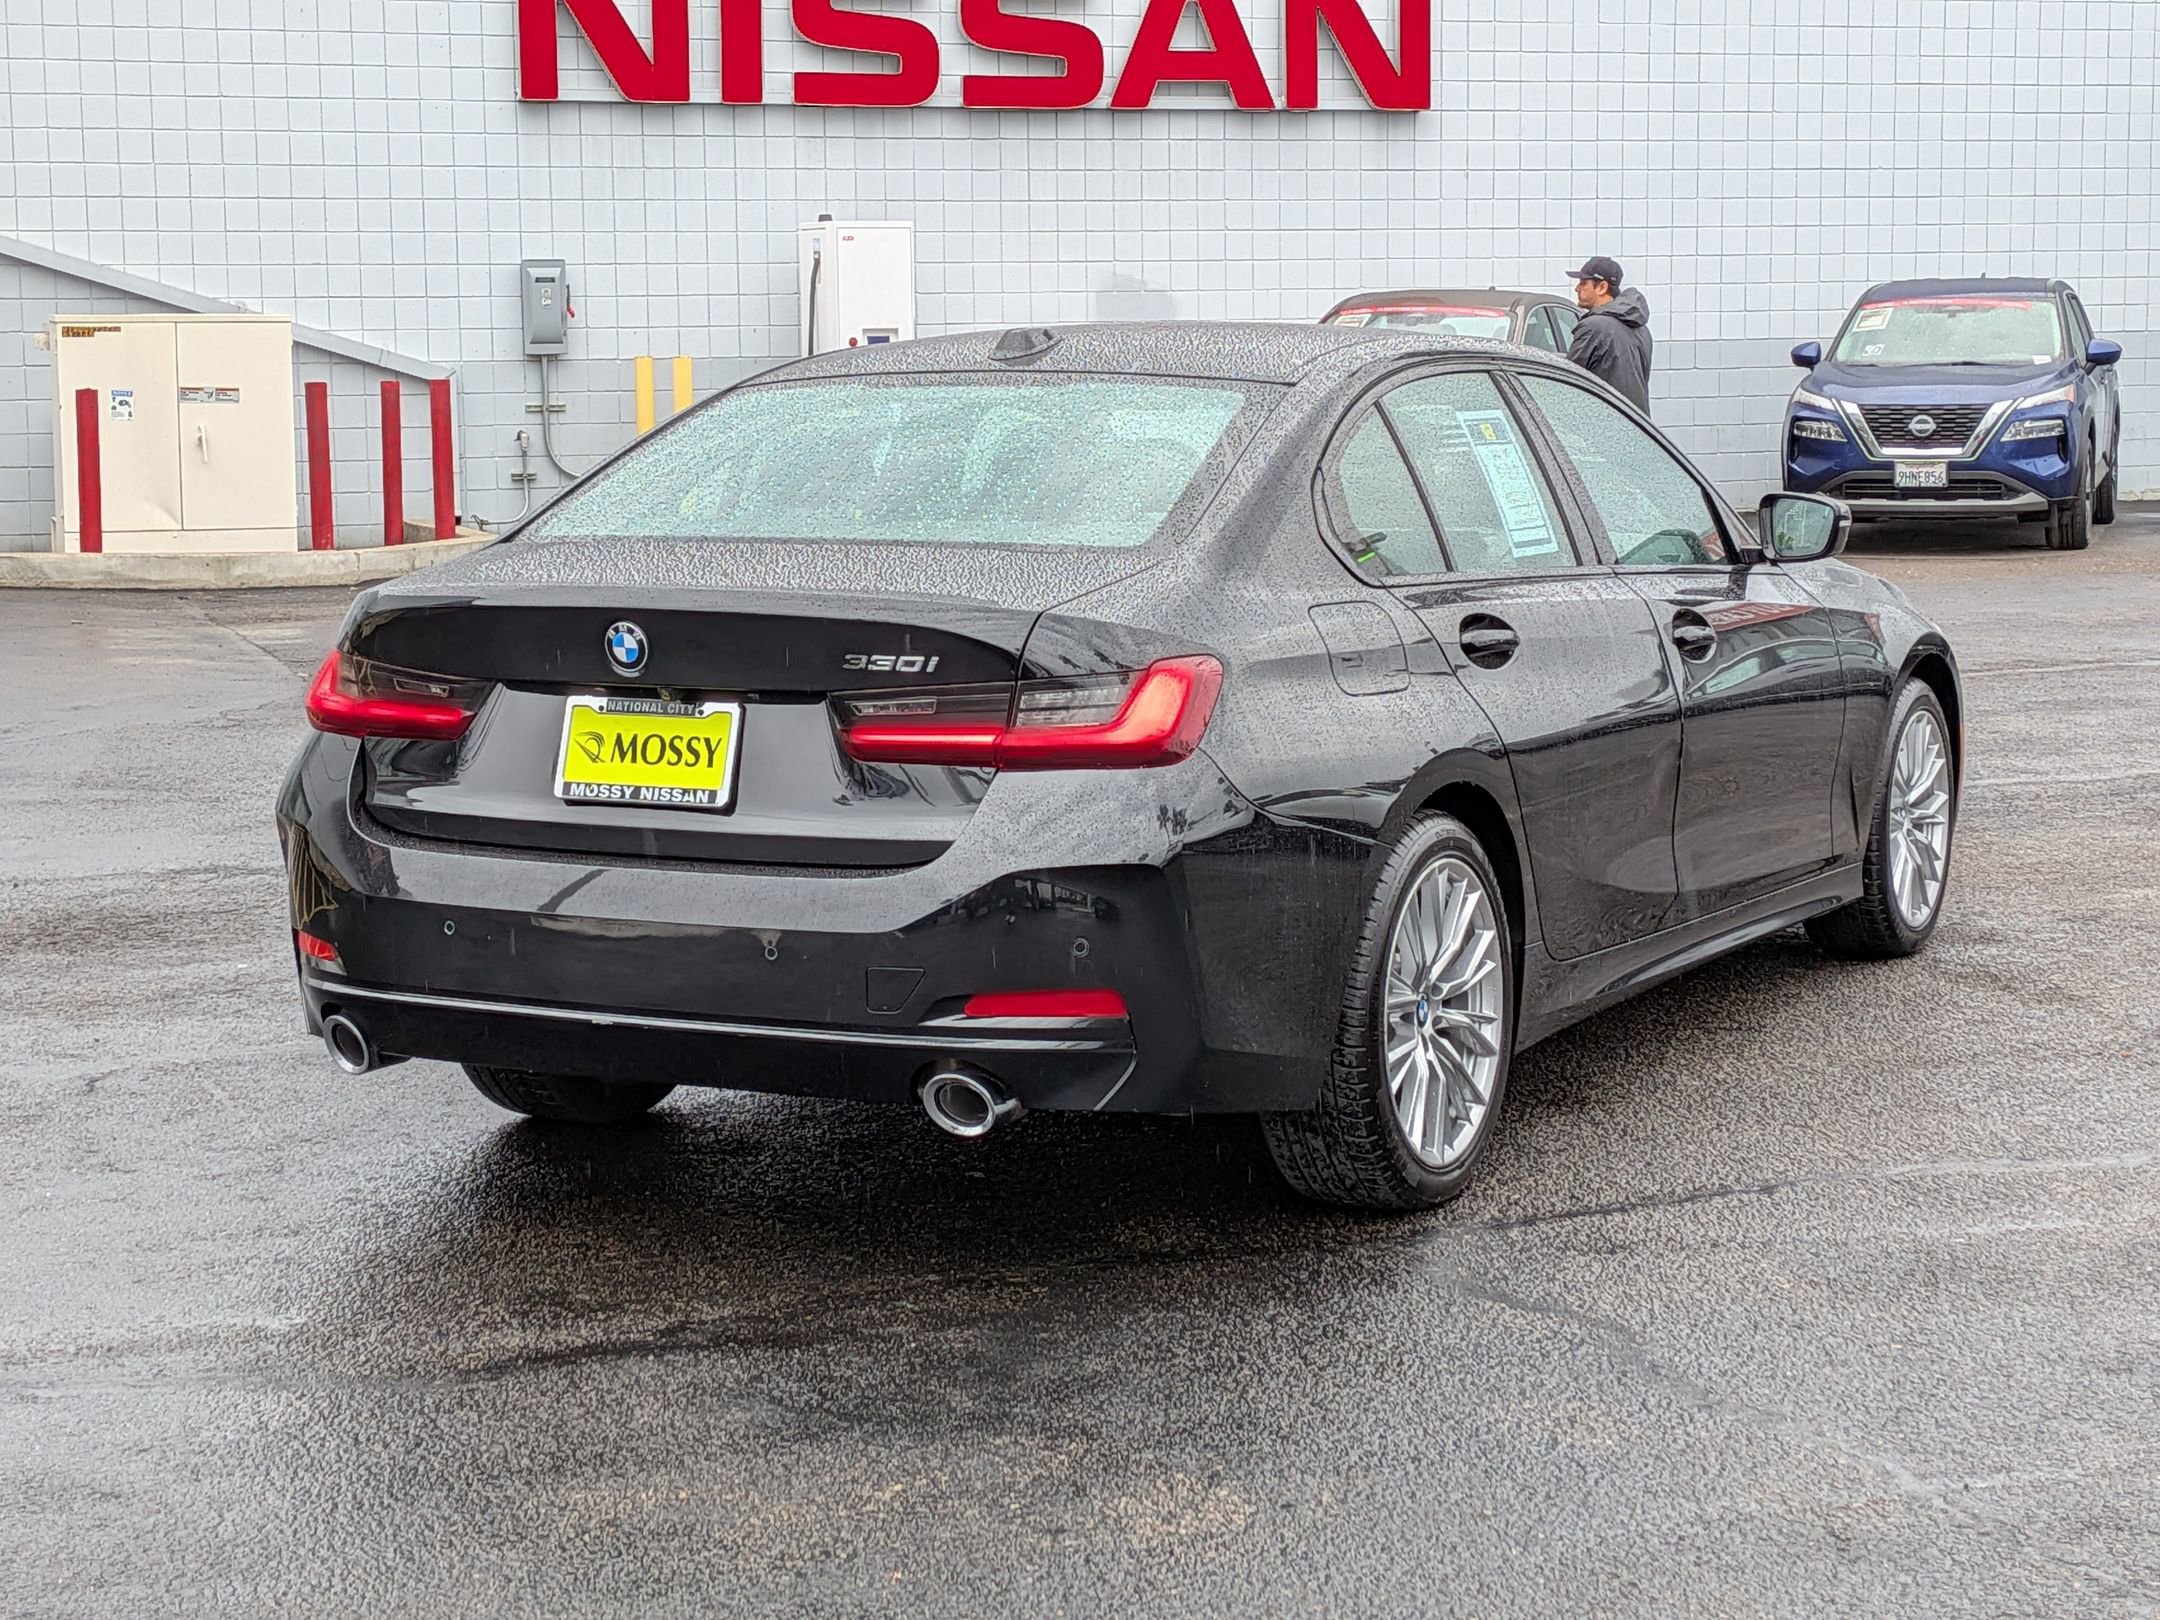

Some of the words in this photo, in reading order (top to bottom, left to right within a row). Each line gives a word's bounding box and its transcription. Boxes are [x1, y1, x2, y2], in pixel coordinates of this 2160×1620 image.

[518, 0, 1431, 110] NISSAN
[842, 654, 940, 672] 330i
[607, 700, 664, 714] NATIONAL
[667, 703, 695, 715] CITY
[610, 732, 723, 769] MOSSY
[570, 783, 636, 800] MOSSY
[640, 786, 710, 803] NISSAN
